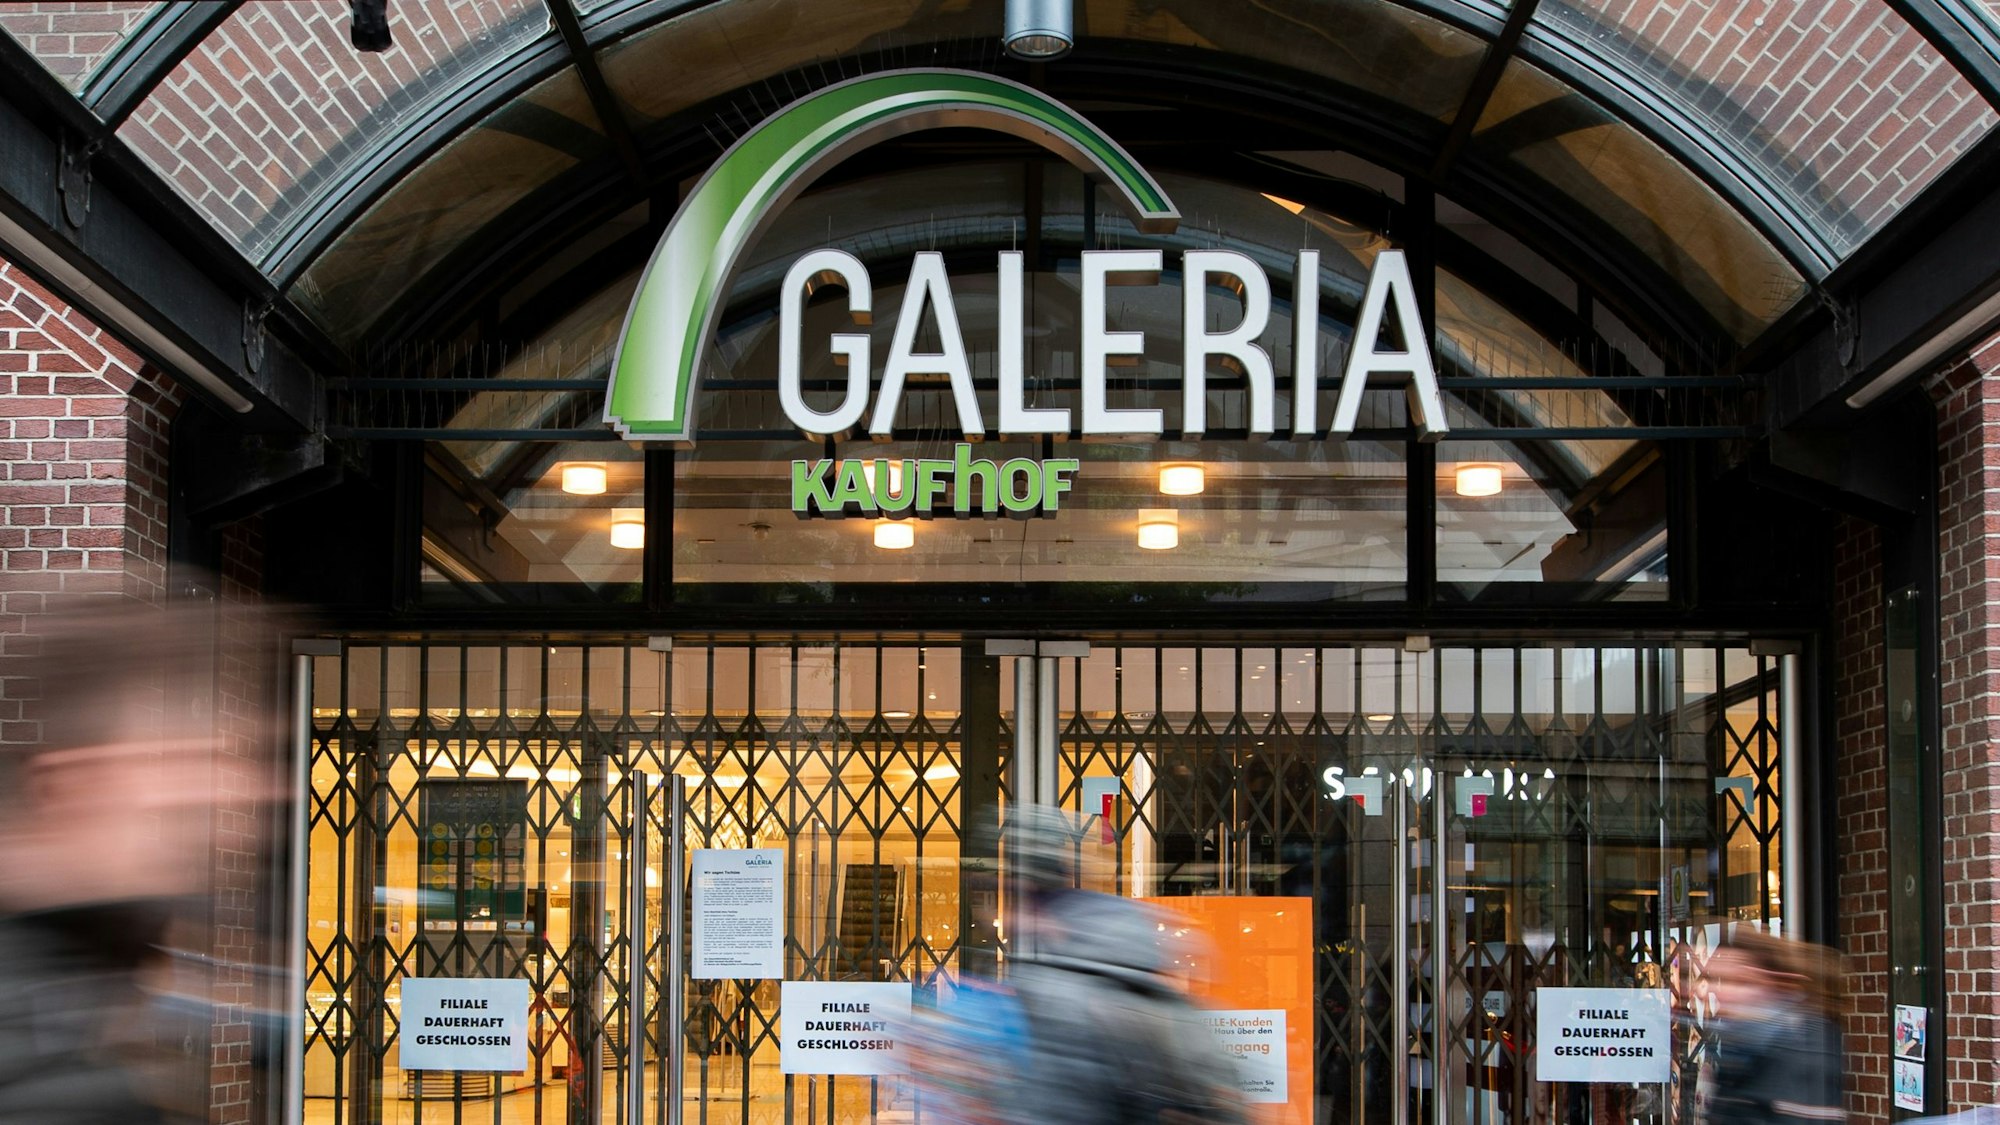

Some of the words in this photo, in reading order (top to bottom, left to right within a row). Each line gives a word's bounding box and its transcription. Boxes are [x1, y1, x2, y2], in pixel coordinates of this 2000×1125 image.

[778, 248, 1451, 441] GALERIA
[440, 999, 488, 1009] FILIALE
[822, 1003, 870, 1013] FILIALE
[1579, 1009, 1628, 1019] FILIALE
[424, 1017, 504, 1028] DAUERHAFT
[805, 1021, 887, 1031] DAUERHAFT
[1214, 1027, 1235, 1035] Haus
[1237, 1027, 1255, 1035] über
[1258, 1027, 1273, 1035] den
[1562, 1028, 1646, 1038] DAUERHAFT
[416, 1035, 511, 1046] GESCHLOSSEN
[797, 1039, 894, 1050] GESCHLOSSEN
[1219, 1040, 1270, 1055] ingang
[1554, 1046, 1653, 1057] GESCHLOSSEN
